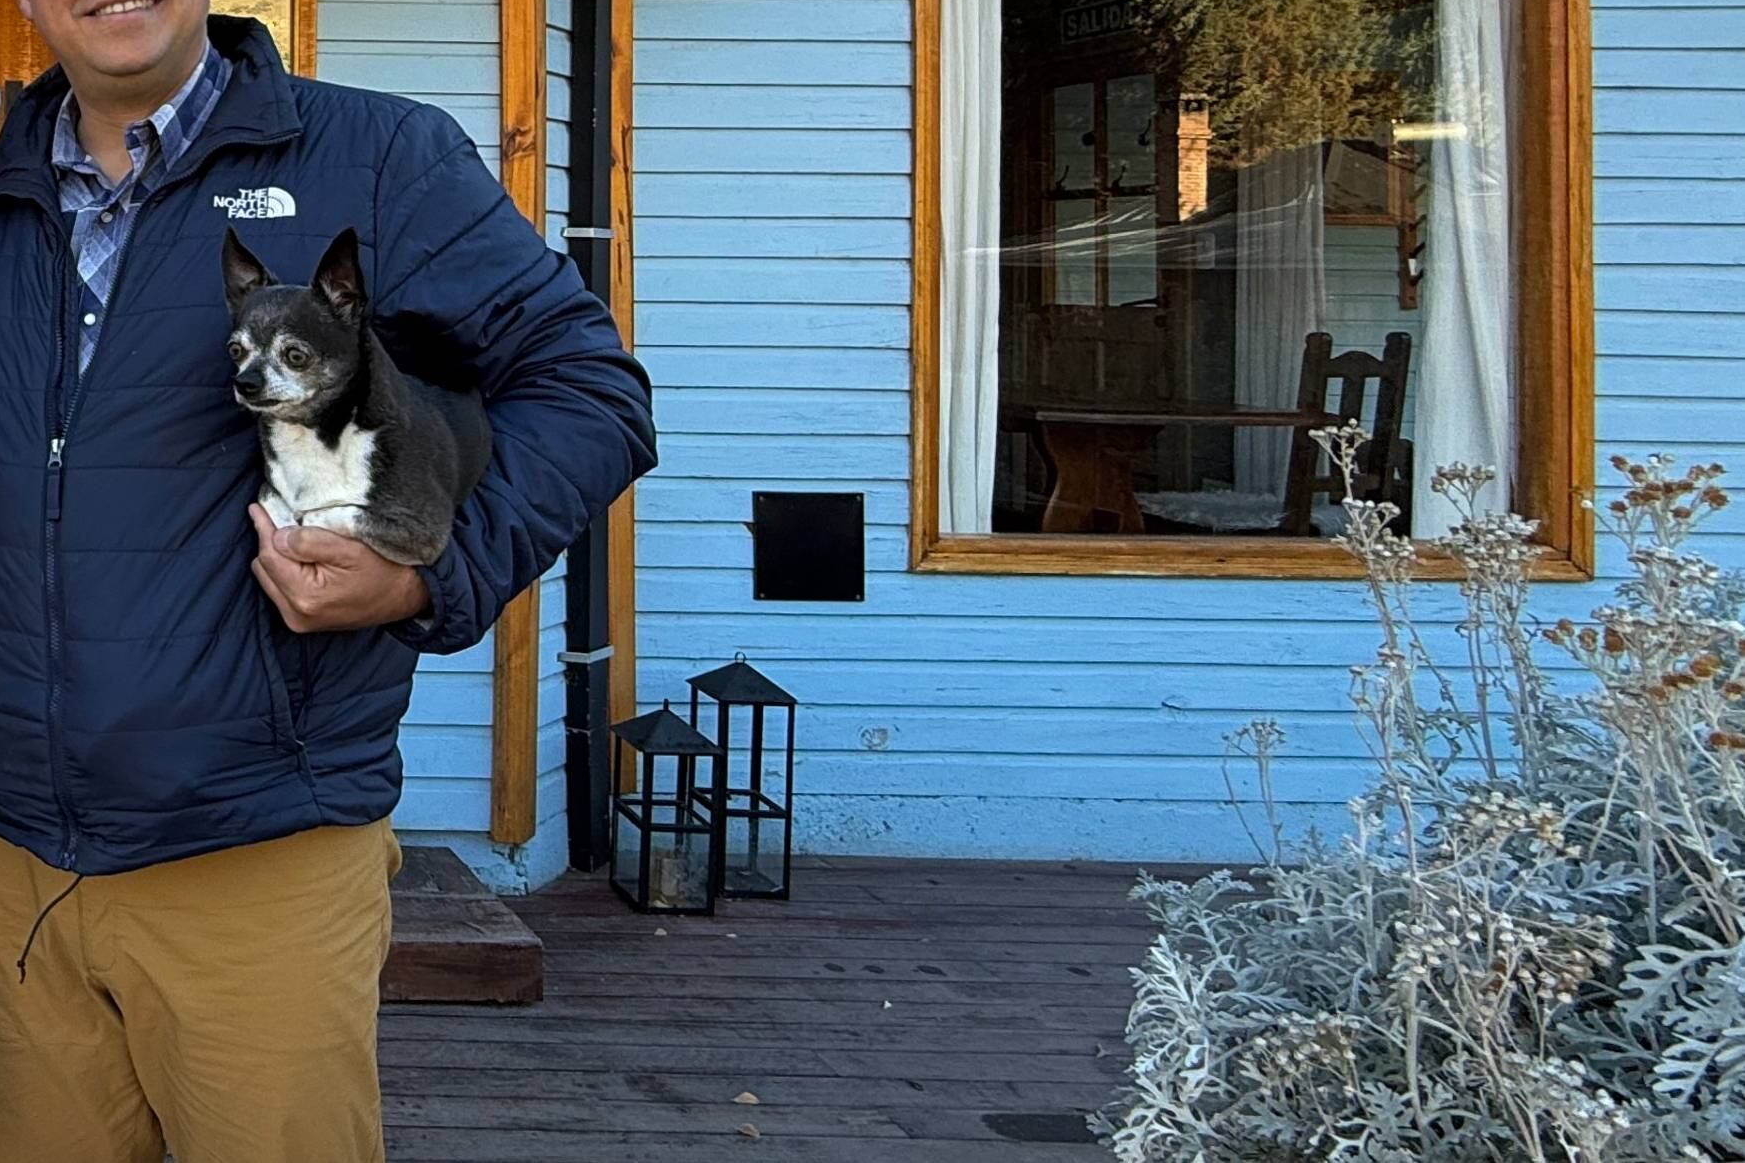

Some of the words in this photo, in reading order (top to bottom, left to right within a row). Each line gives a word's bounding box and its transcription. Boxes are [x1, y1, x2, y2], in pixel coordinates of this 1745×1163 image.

[1066, 1, 1135, 37] SALIDA
[236, 188, 268, 199] THE
[213, 195, 268, 209] NORTH
[228, 207, 267, 219] FACE
